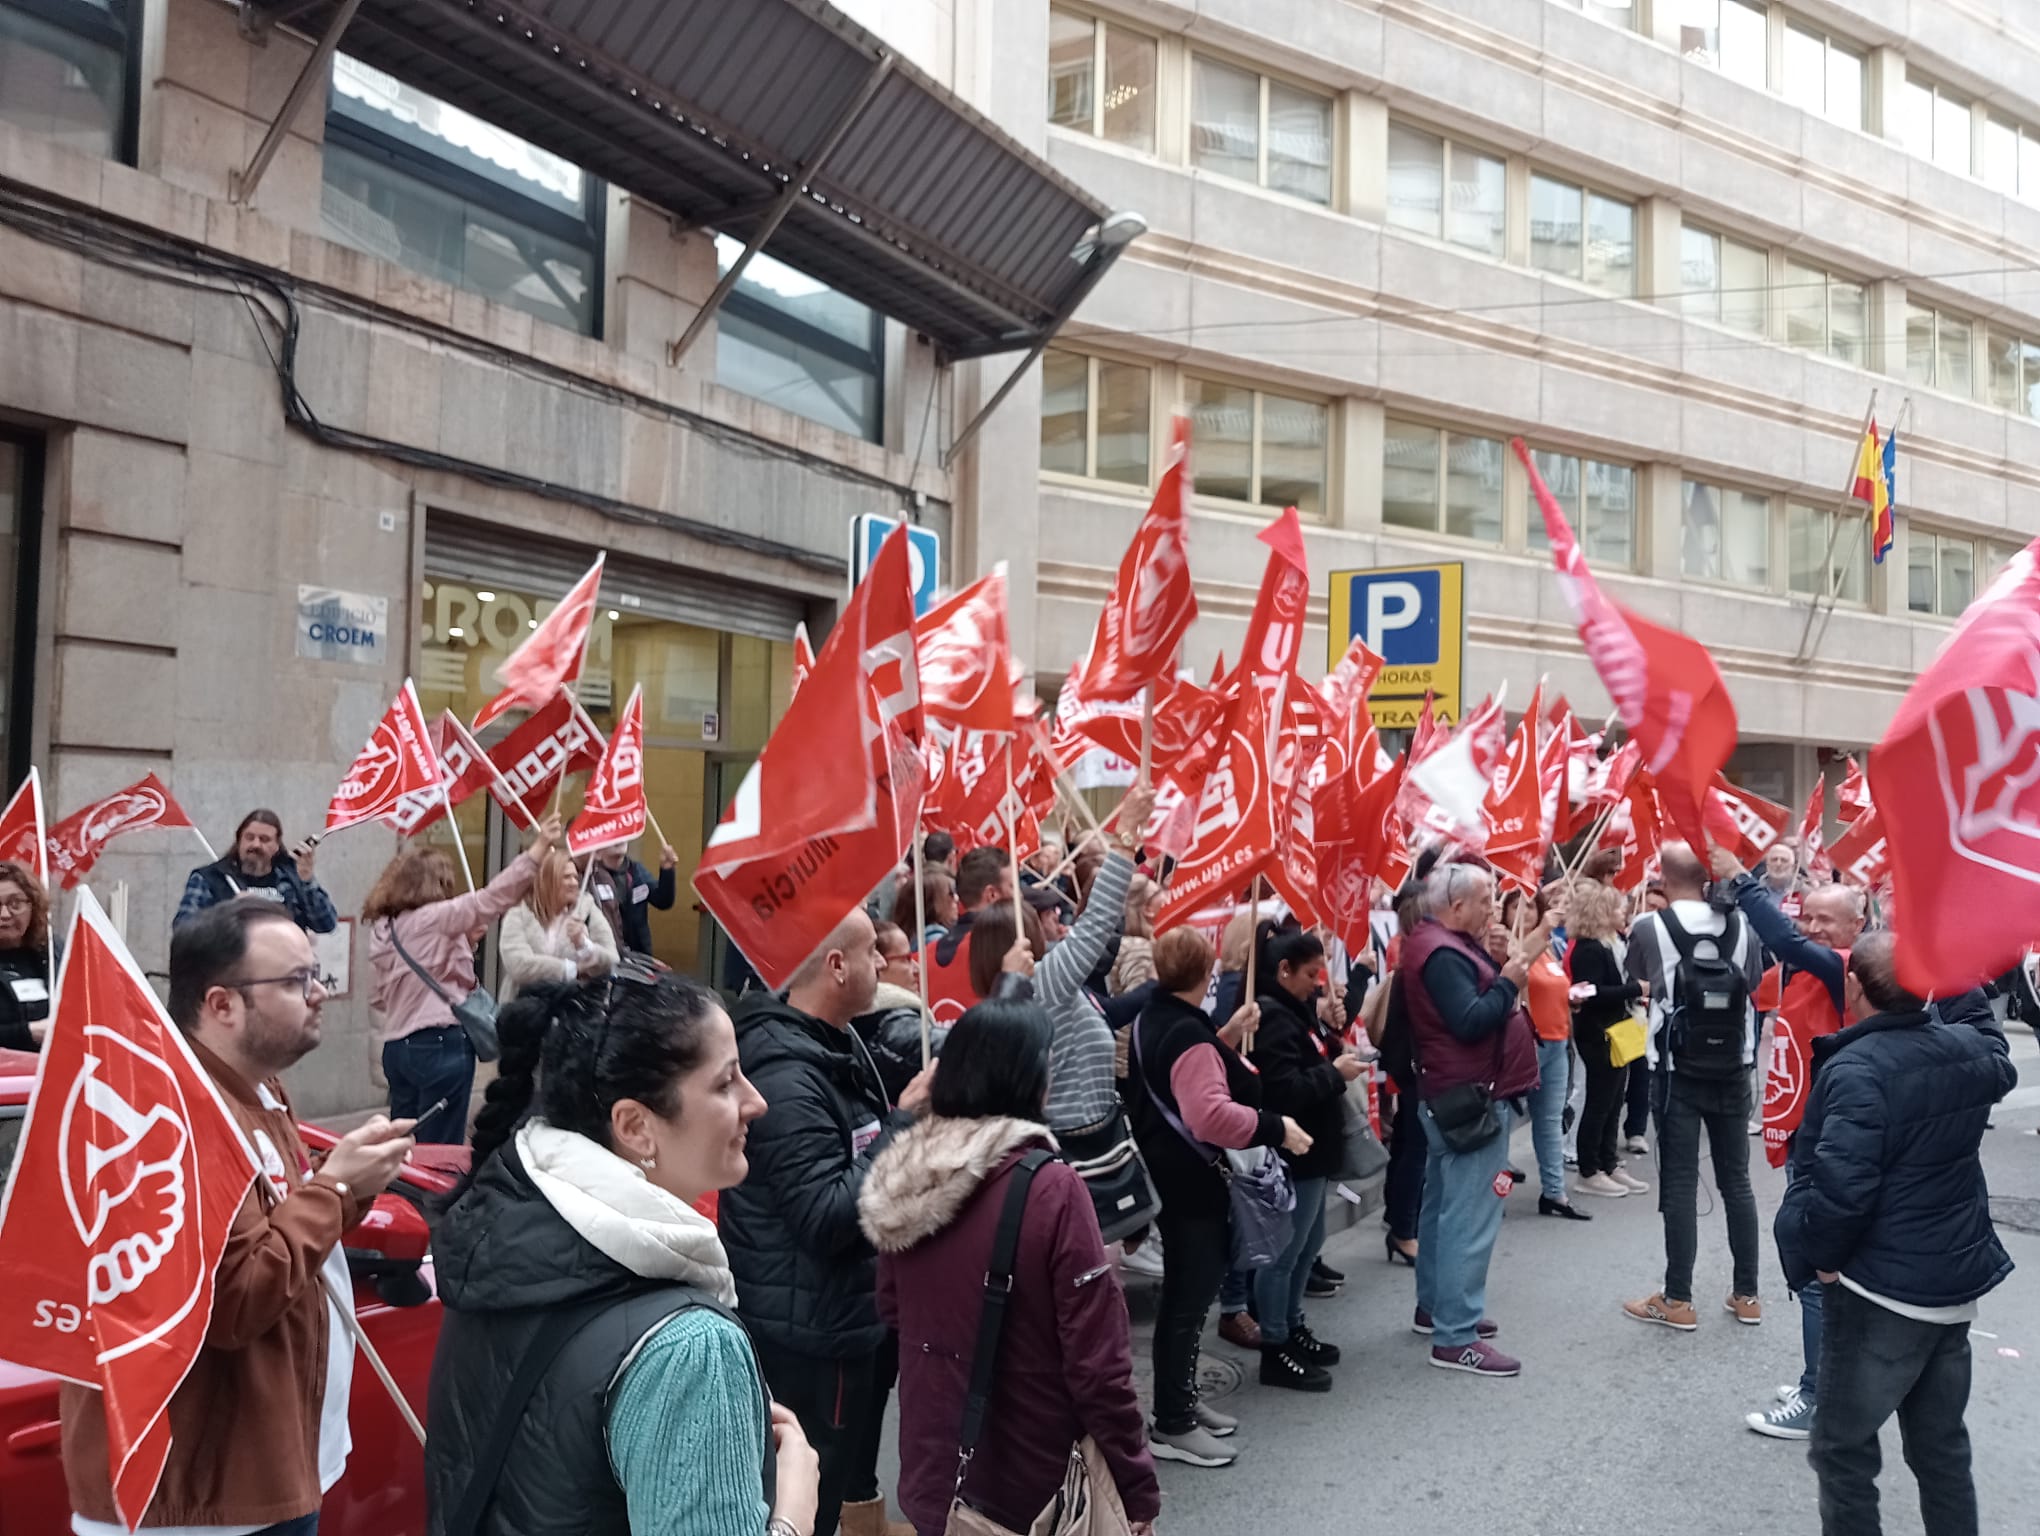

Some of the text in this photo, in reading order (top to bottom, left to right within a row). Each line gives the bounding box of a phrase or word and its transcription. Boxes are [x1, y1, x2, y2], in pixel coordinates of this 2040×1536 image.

[1367, 581, 1421, 658] P
[309, 623, 374, 648] CROEM
[1376, 670, 1433, 684] HORAS
[1371, 710, 1454, 724] TRAA
